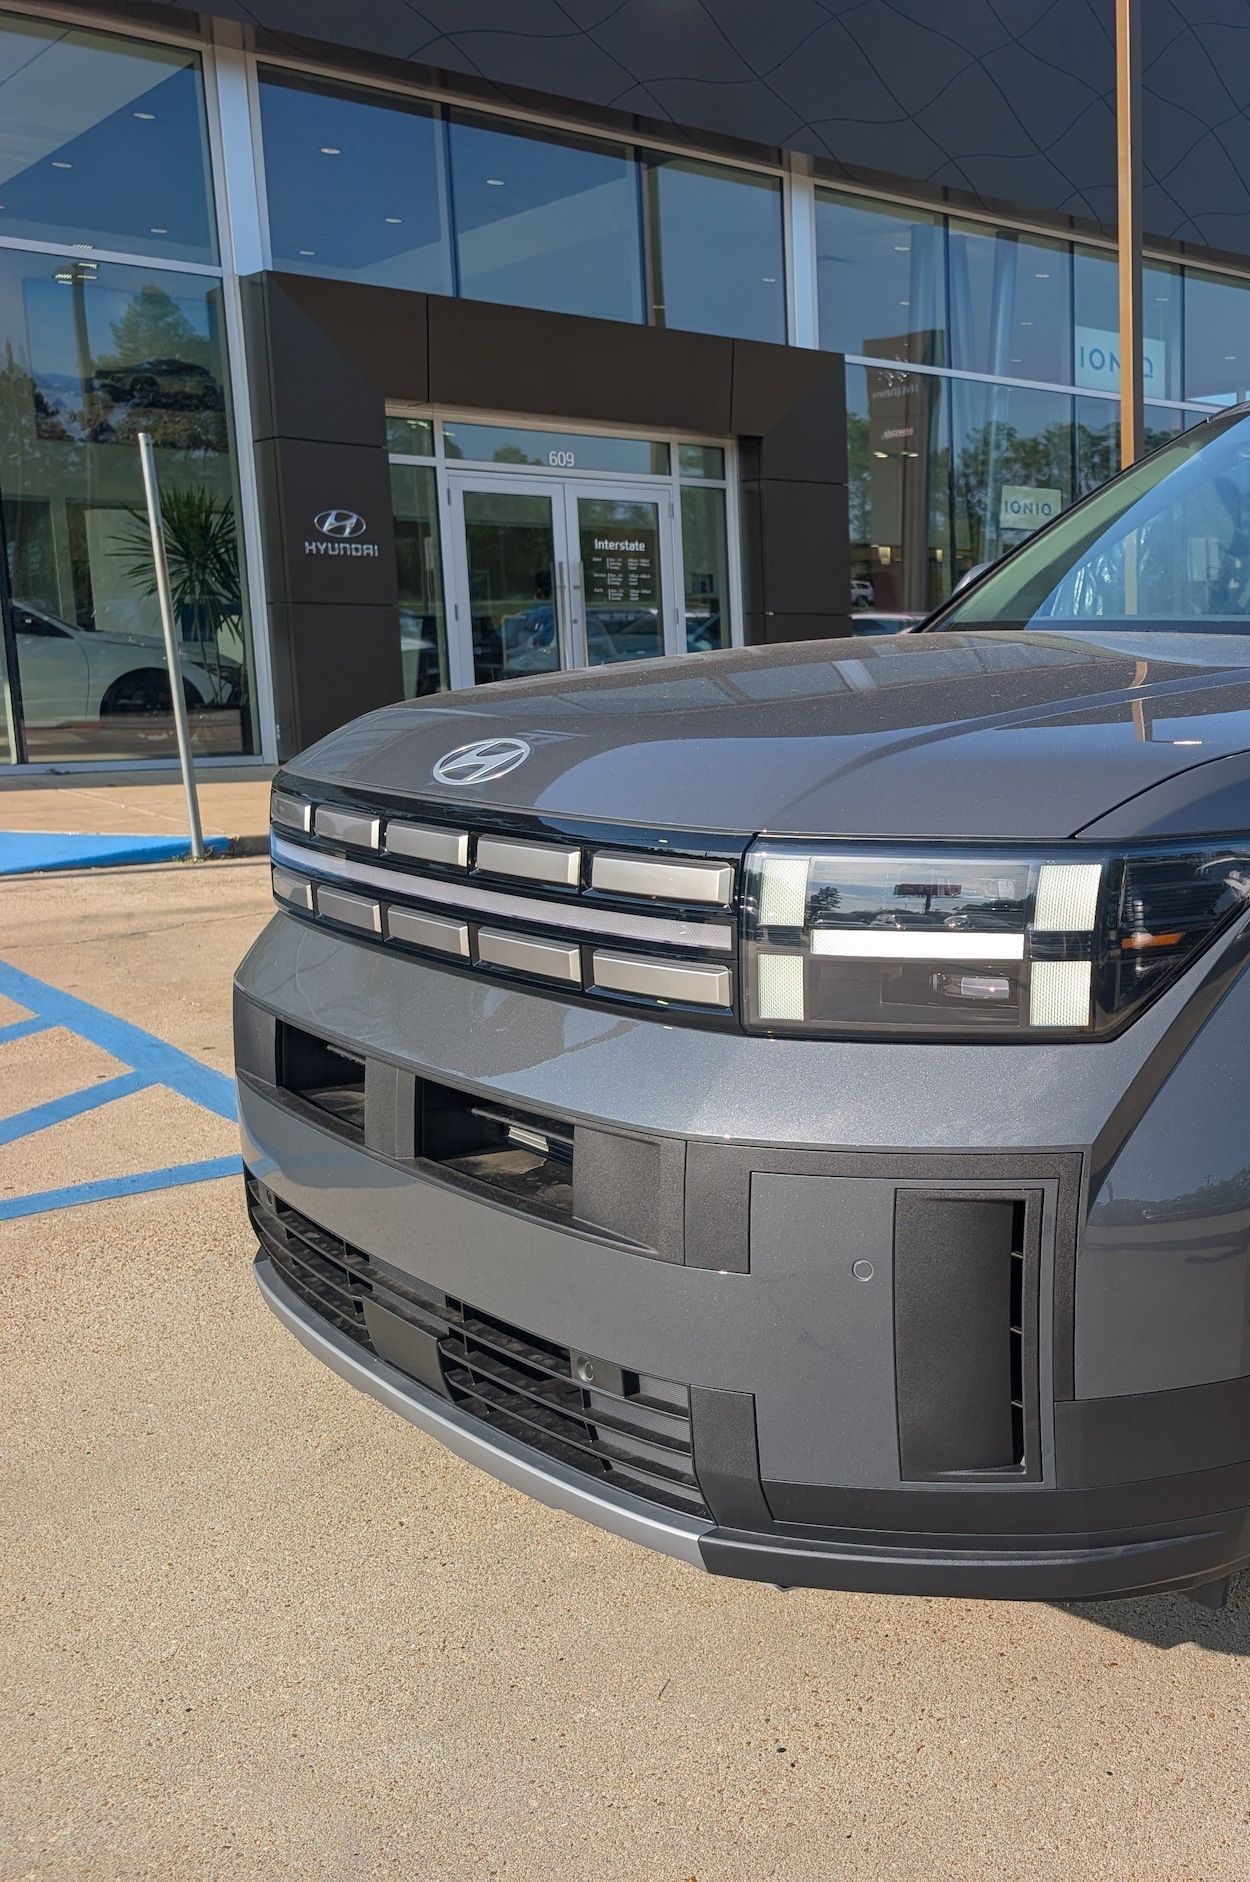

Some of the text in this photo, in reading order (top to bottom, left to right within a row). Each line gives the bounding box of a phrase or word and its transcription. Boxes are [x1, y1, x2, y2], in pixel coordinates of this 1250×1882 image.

[1080, 346, 1154, 379] IONQ
[549, 451, 575, 467] 609
[1004, 500, 1052, 517] IONIQ
[304, 541, 379, 557] HYUNDAI
[594, 538, 646, 552] Interstate
